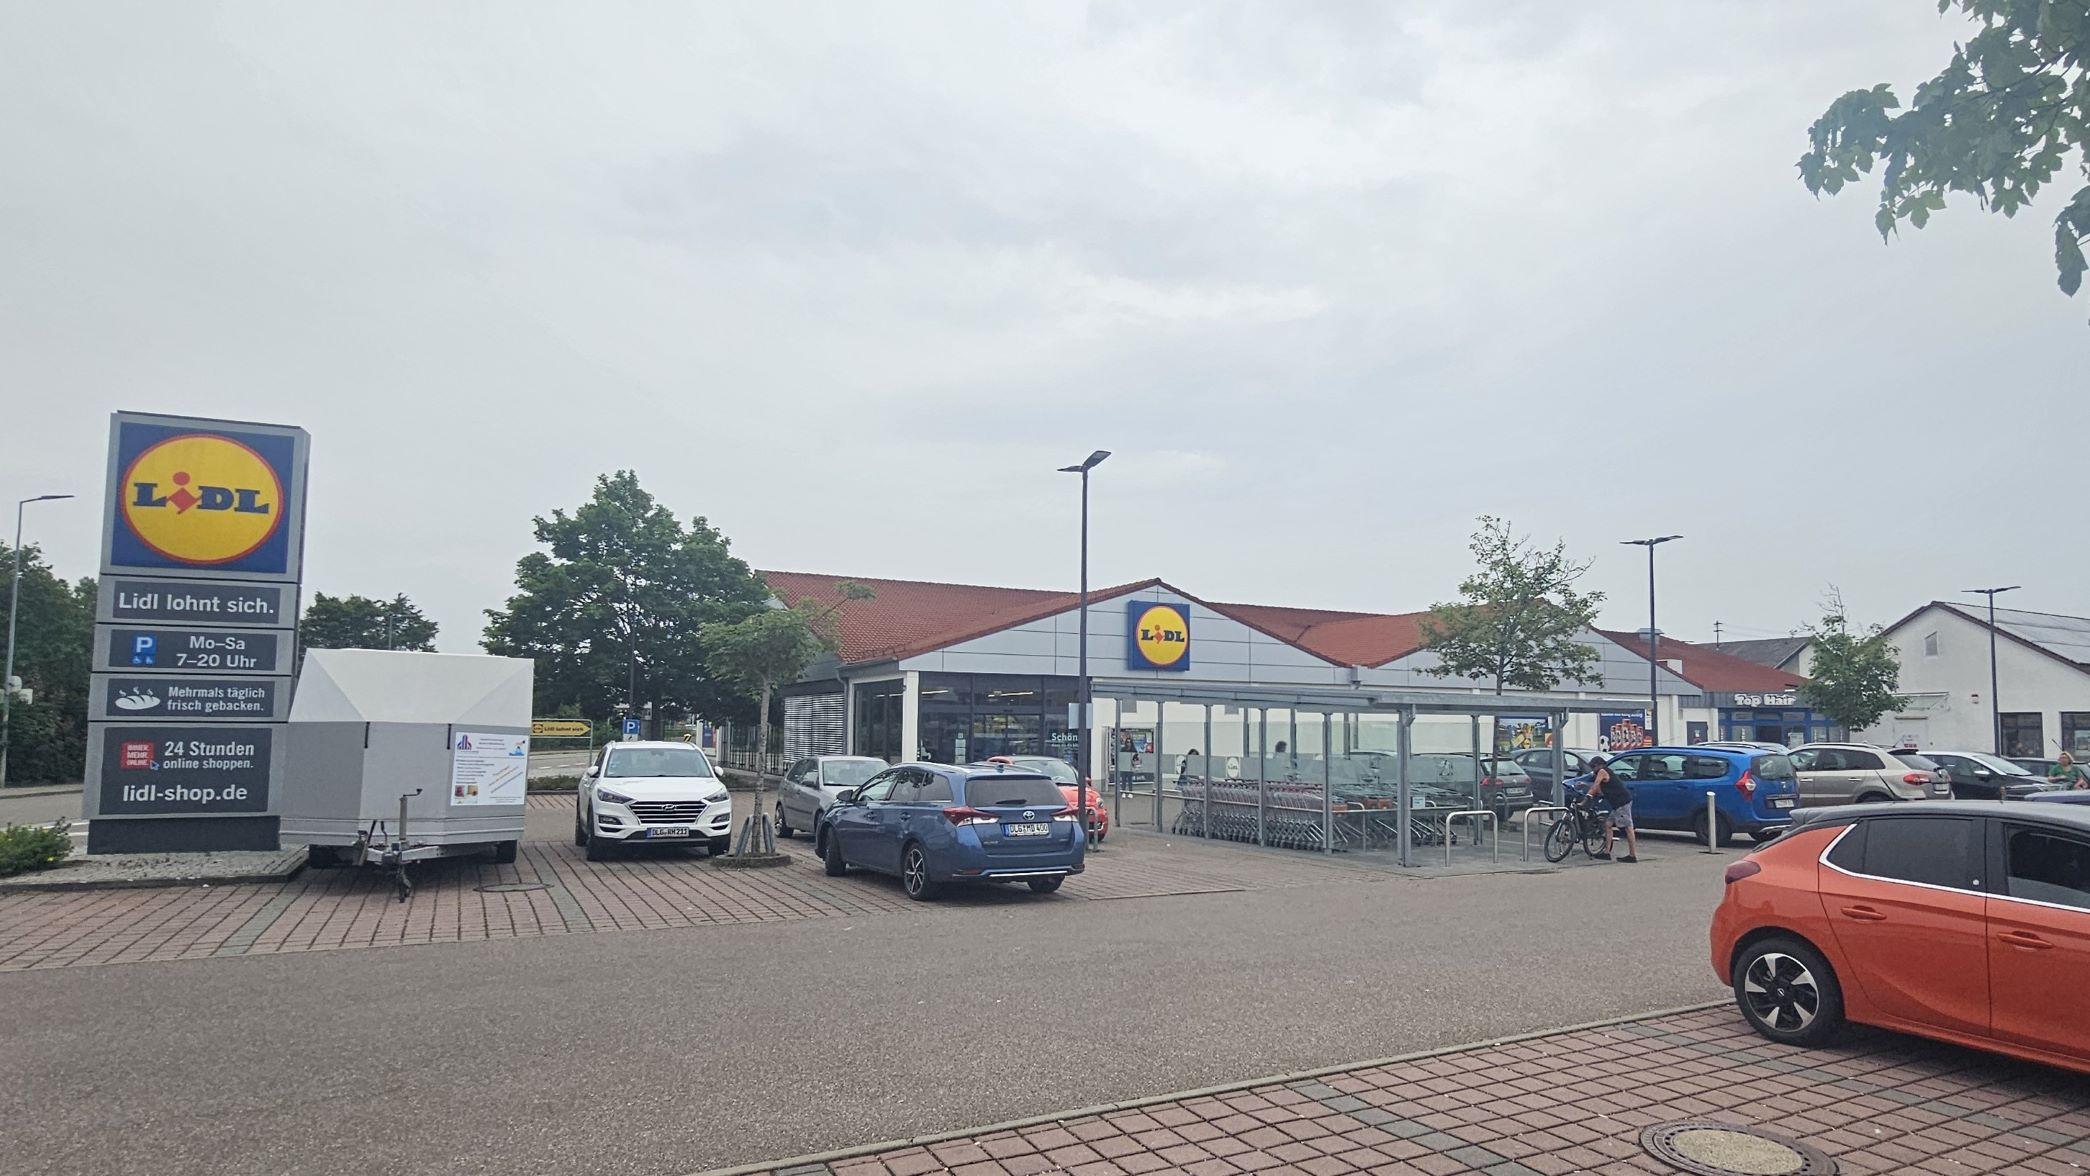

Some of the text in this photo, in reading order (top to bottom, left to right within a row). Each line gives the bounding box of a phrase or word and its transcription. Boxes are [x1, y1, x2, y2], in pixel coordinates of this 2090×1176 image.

[118, 592, 275, 614] Lidl lohnt sich.
[136, 636, 153, 653] P
[226, 654, 257, 668] Uhr
[168, 686, 265, 700] Mehrmals täglich
[1734, 693, 1797, 707] Top Hair
[167, 700, 264, 713] frisch gebacken.
[626, 721, 636, 734] P
[164, 741, 255, 757] 24 Stunden
[163, 758, 254, 771] online shoppen.
[122, 784, 248, 804] lidl-shop.de
